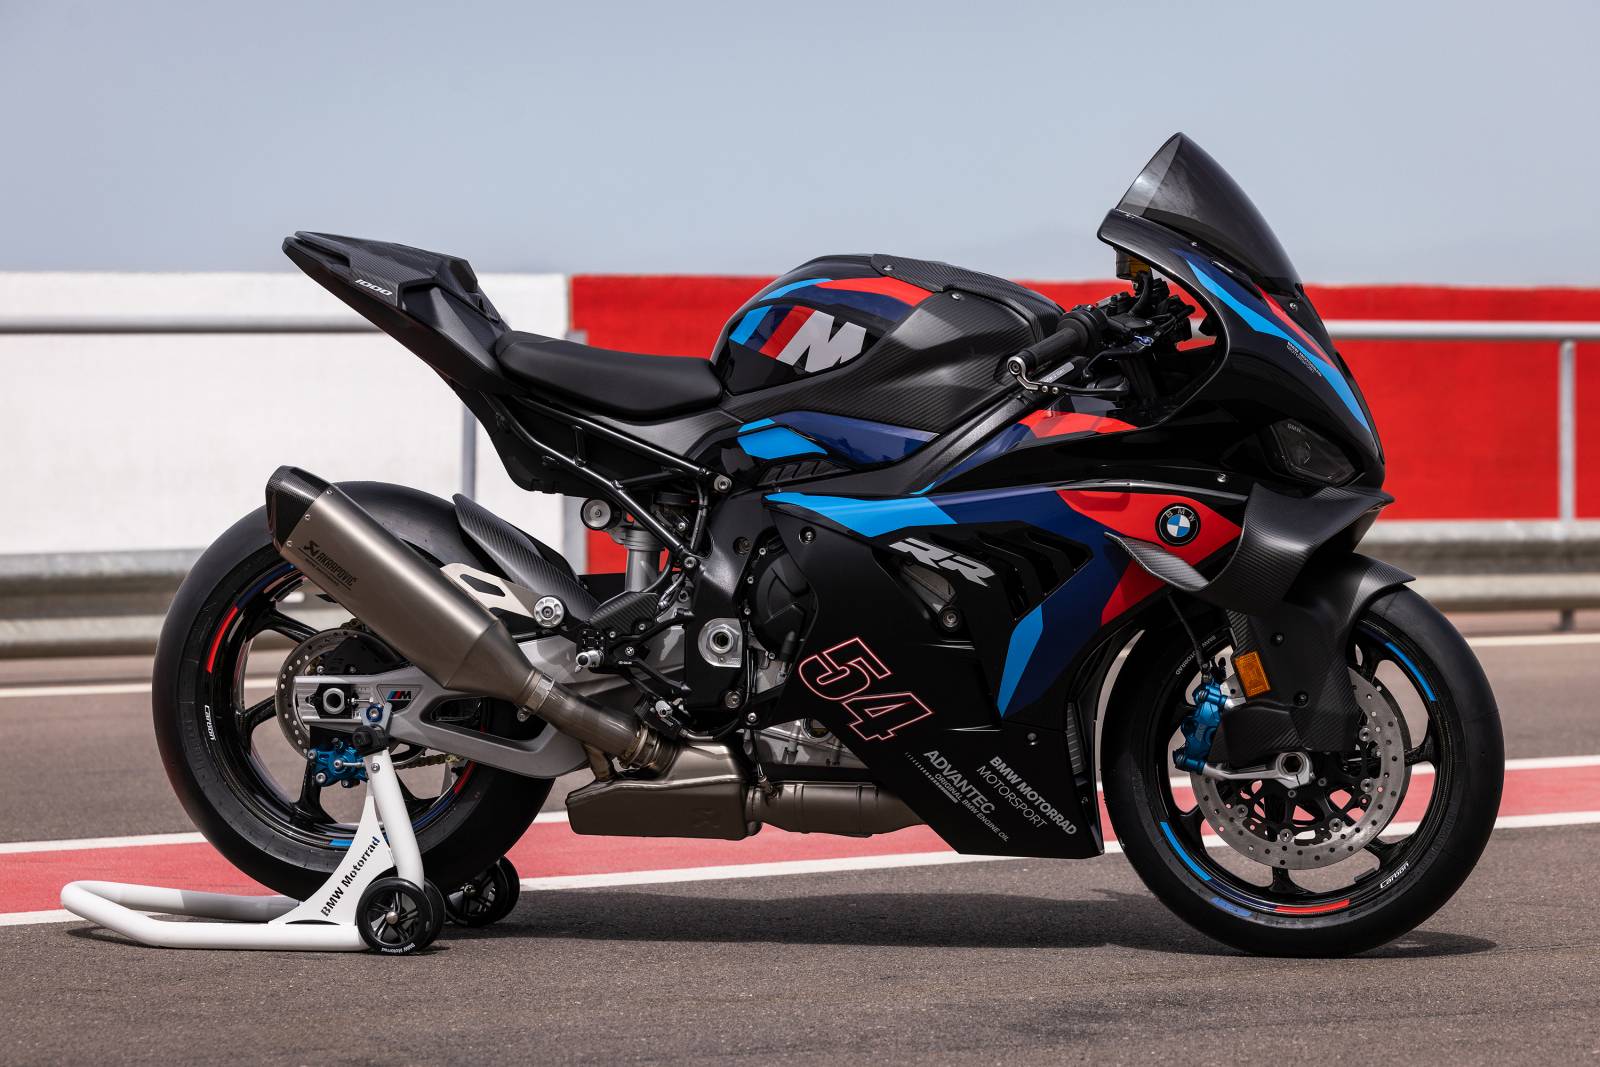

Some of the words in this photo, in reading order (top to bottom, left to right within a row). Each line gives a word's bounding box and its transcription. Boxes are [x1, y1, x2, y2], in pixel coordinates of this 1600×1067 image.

[355, 279, 393, 296] 1000
[776, 310, 868, 373] M
[888, 537, 995, 587] RR
[798, 637, 935, 741] 54
[204, 704, 216, 741] Carbon
[924, 750, 996, 814] ADVANTEC
[934, 773, 962, 801] ORIGINAL
[961, 799, 980, 815] BMW
[976, 812, 1001, 837] ENGINE
[998, 831, 1009, 842] OIL
[976, 765, 1048, 829] MOTORSPORT
[989, 756, 1021, 785] BMW
[1016, 781, 1077, 836] MOTORRAD
[320, 886, 345, 917] BMW
[341, 836, 380, 888] Motorrad
[1380, 860, 1409, 889] Carbon
